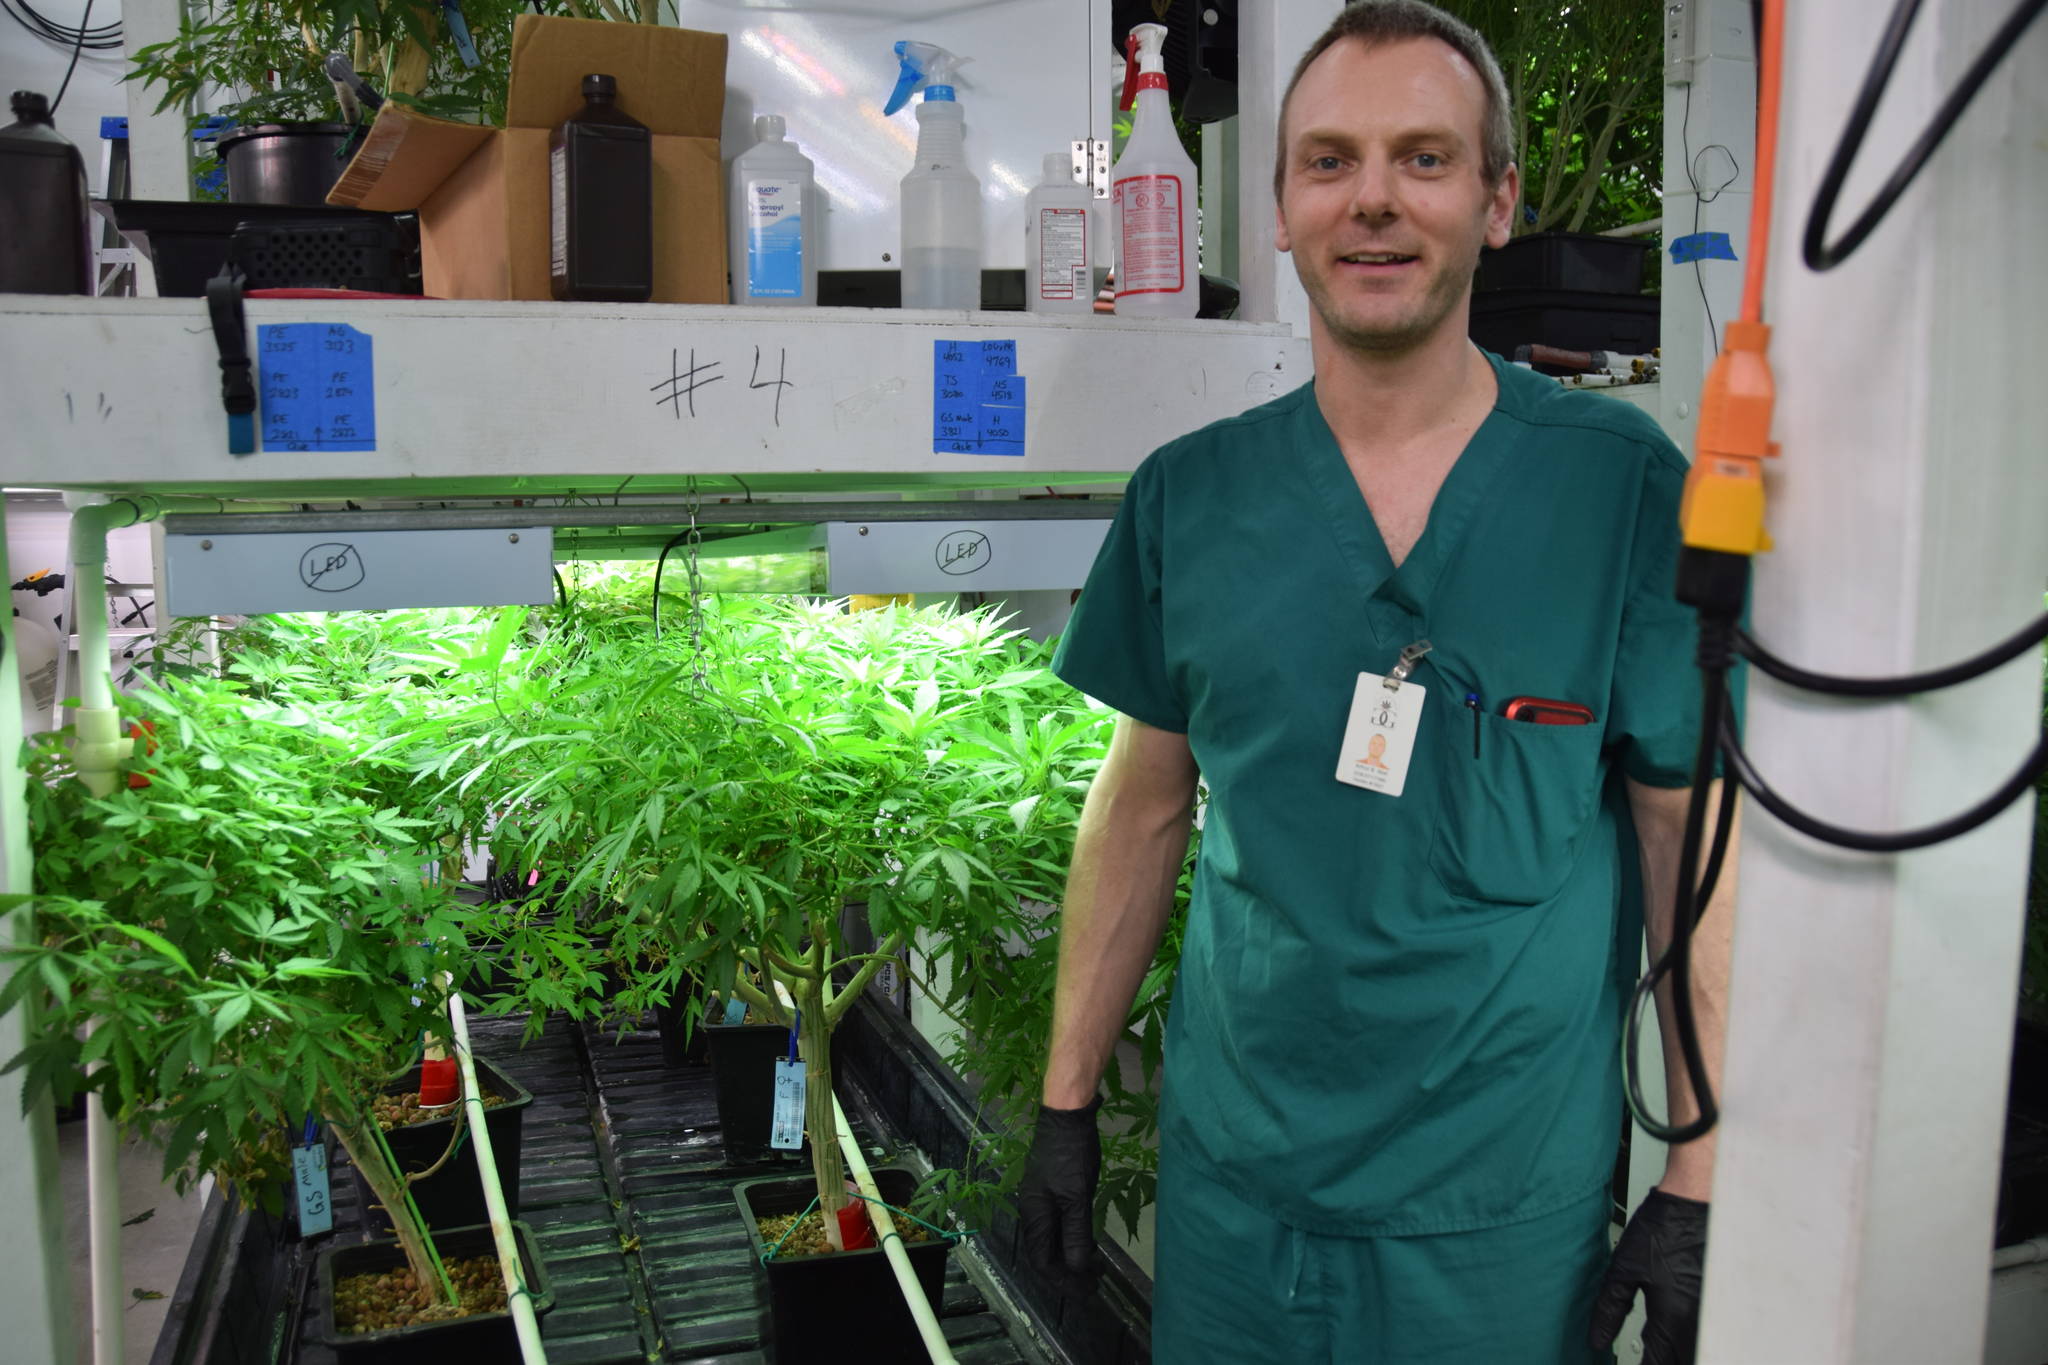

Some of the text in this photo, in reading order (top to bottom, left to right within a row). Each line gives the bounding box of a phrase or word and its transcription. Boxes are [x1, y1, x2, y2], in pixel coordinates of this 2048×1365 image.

[986, 356, 1011, 369] 4769
[943, 374, 958, 386] TS
[940, 412, 954, 423] GS
[945, 542, 978, 562] LED
[311, 554, 348, 577] LED
[306, 1190, 326, 1216] GS
